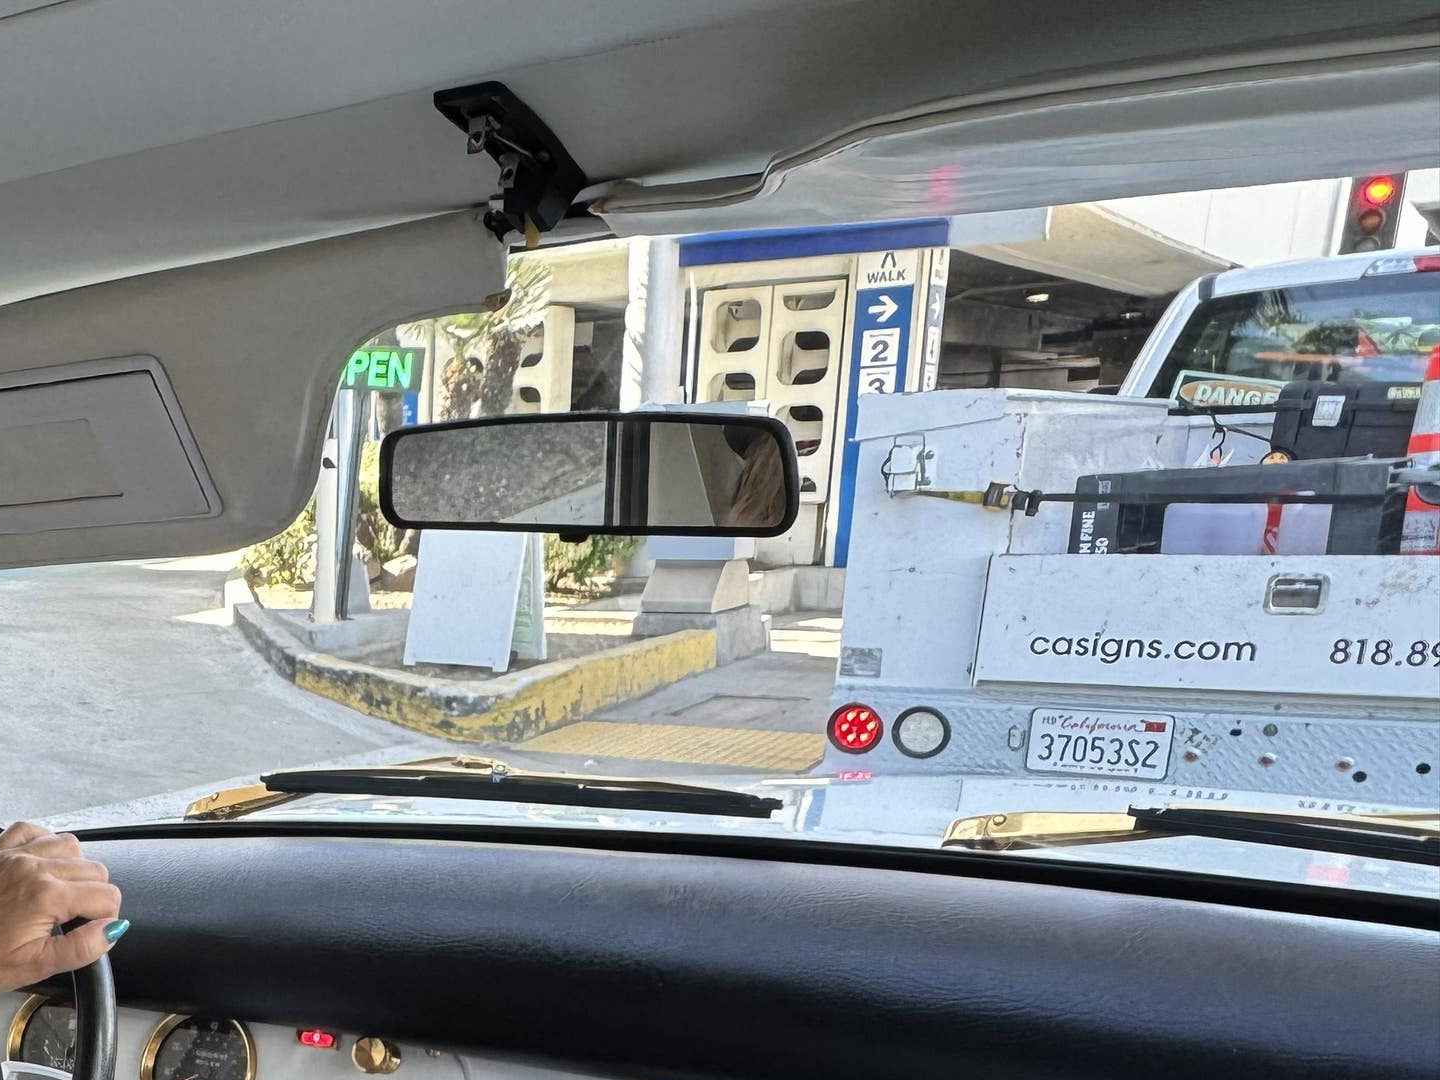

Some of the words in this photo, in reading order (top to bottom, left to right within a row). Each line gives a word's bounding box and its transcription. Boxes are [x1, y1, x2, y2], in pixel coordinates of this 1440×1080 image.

[867, 269, 906, 284] WALK
[870, 340, 889, 363] 2
[345, 350, 413, 389] PEN
[1195, 384, 1282, 406] DANGE
[1029, 632, 1257, 664] casigns.com
[1037, 733, 1160, 769] 37053S2
